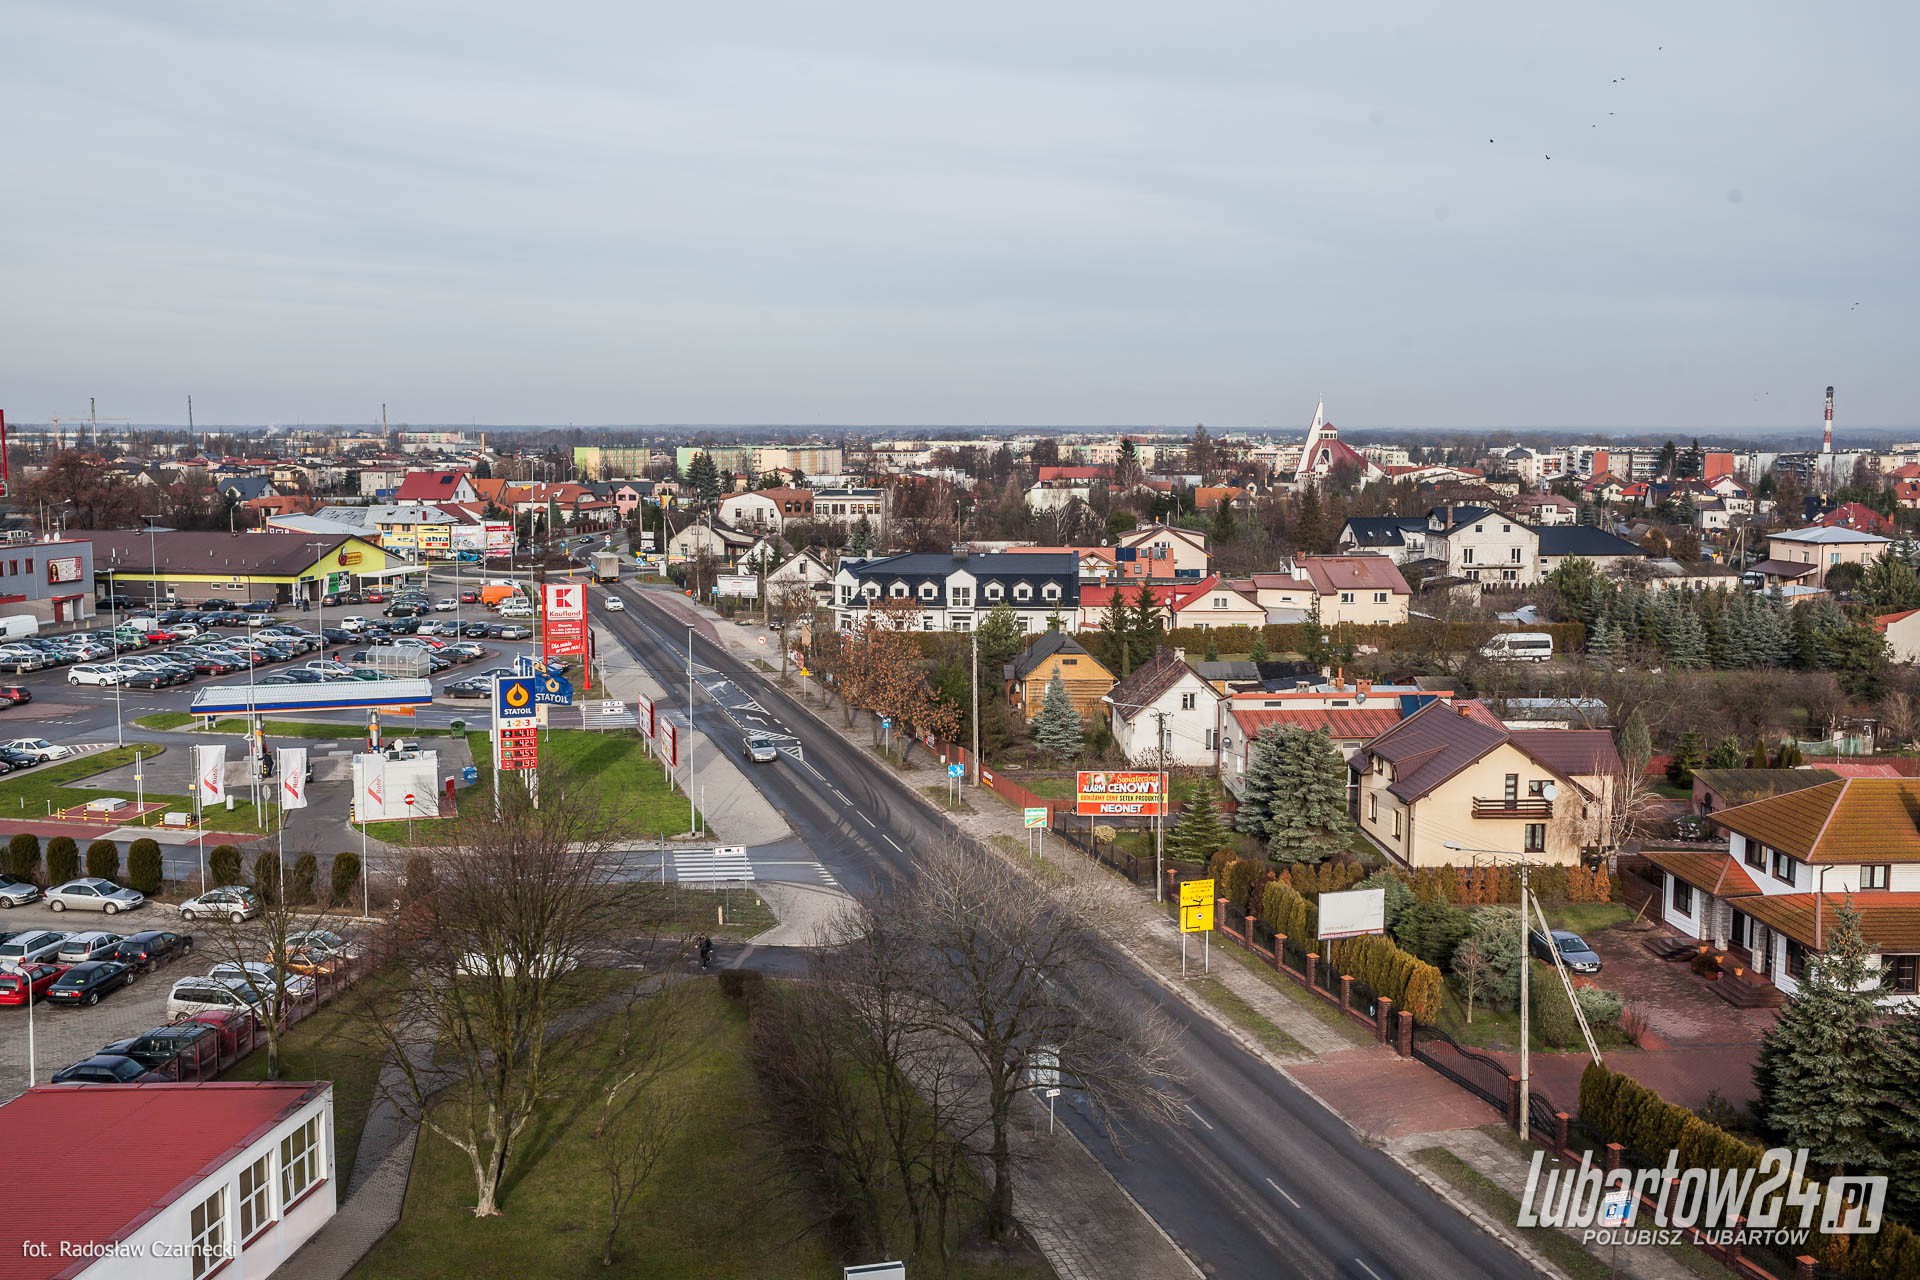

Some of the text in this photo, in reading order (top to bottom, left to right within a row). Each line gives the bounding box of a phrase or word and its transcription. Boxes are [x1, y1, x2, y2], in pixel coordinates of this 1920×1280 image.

[535, 693, 569, 704] STATOIL
[1108, 782, 1159, 793] CENOWY
[1100, 804, 1144, 813] NEONET
